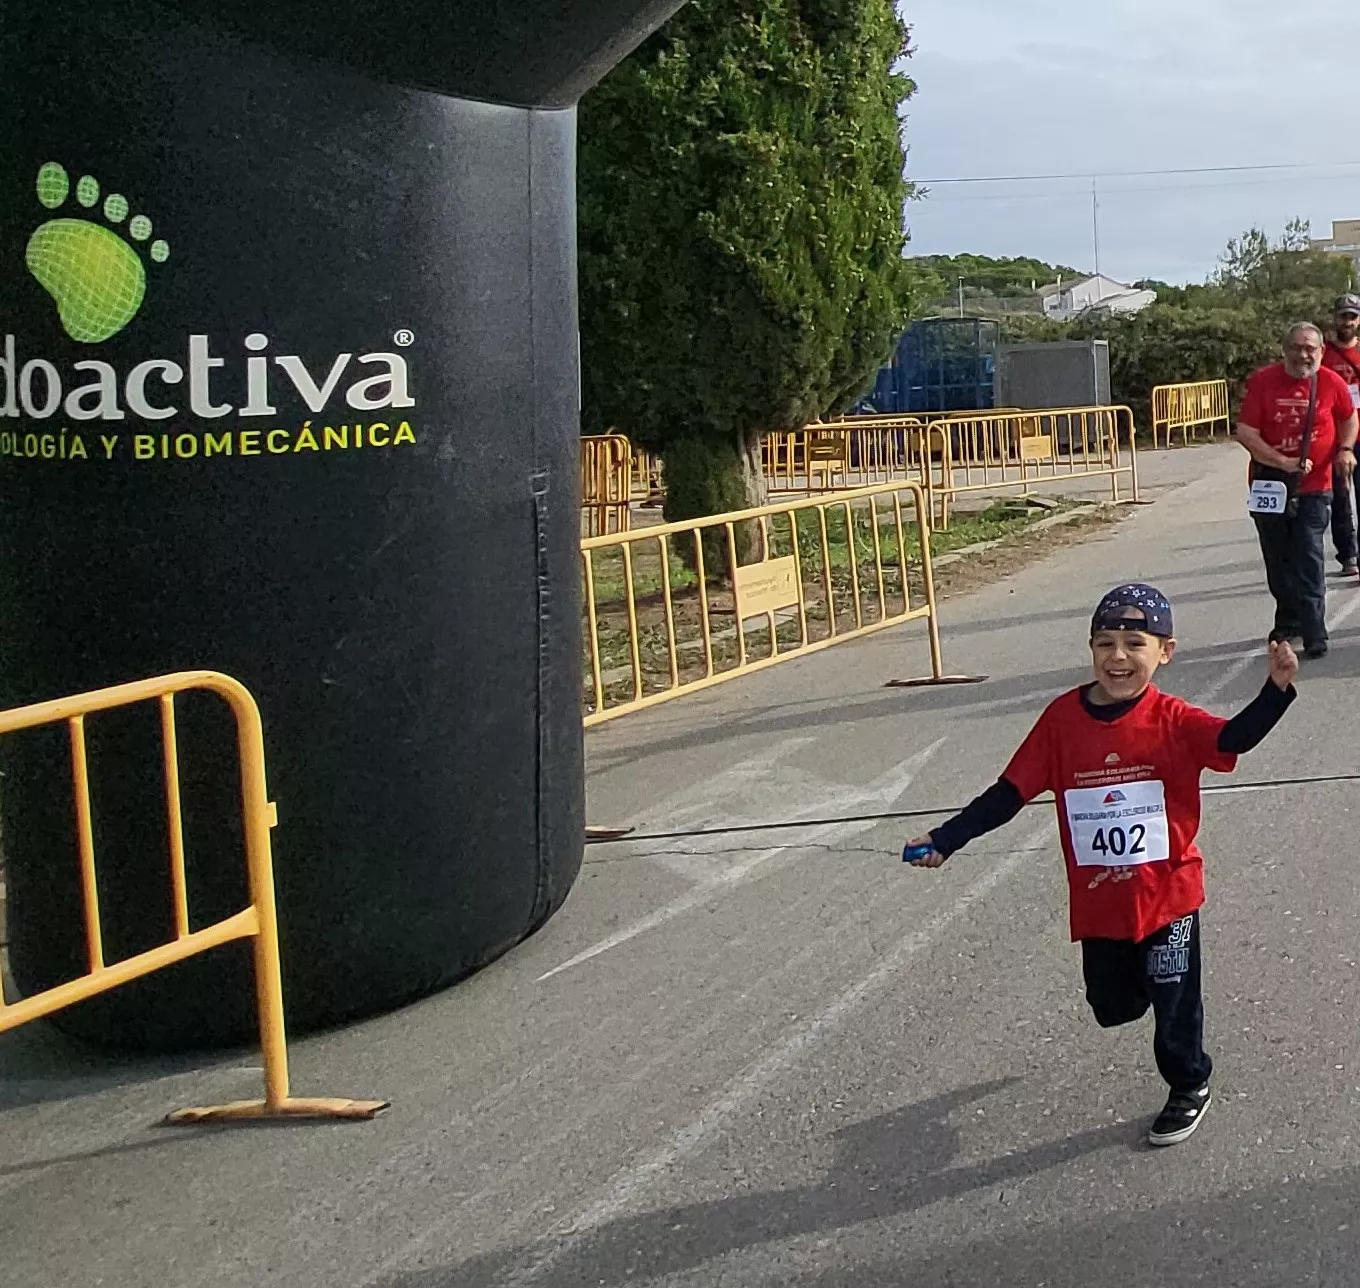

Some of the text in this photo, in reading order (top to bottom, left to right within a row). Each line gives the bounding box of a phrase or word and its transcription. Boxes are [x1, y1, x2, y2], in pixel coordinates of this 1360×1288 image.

[101, 434, 119, 459] Y
[134, 420, 417, 460] BIOMECÁNICA
[1257, 496, 1277, 509] 293
[1092, 823, 1147, 857] 402
[1168, 915, 1193, 944] 37
